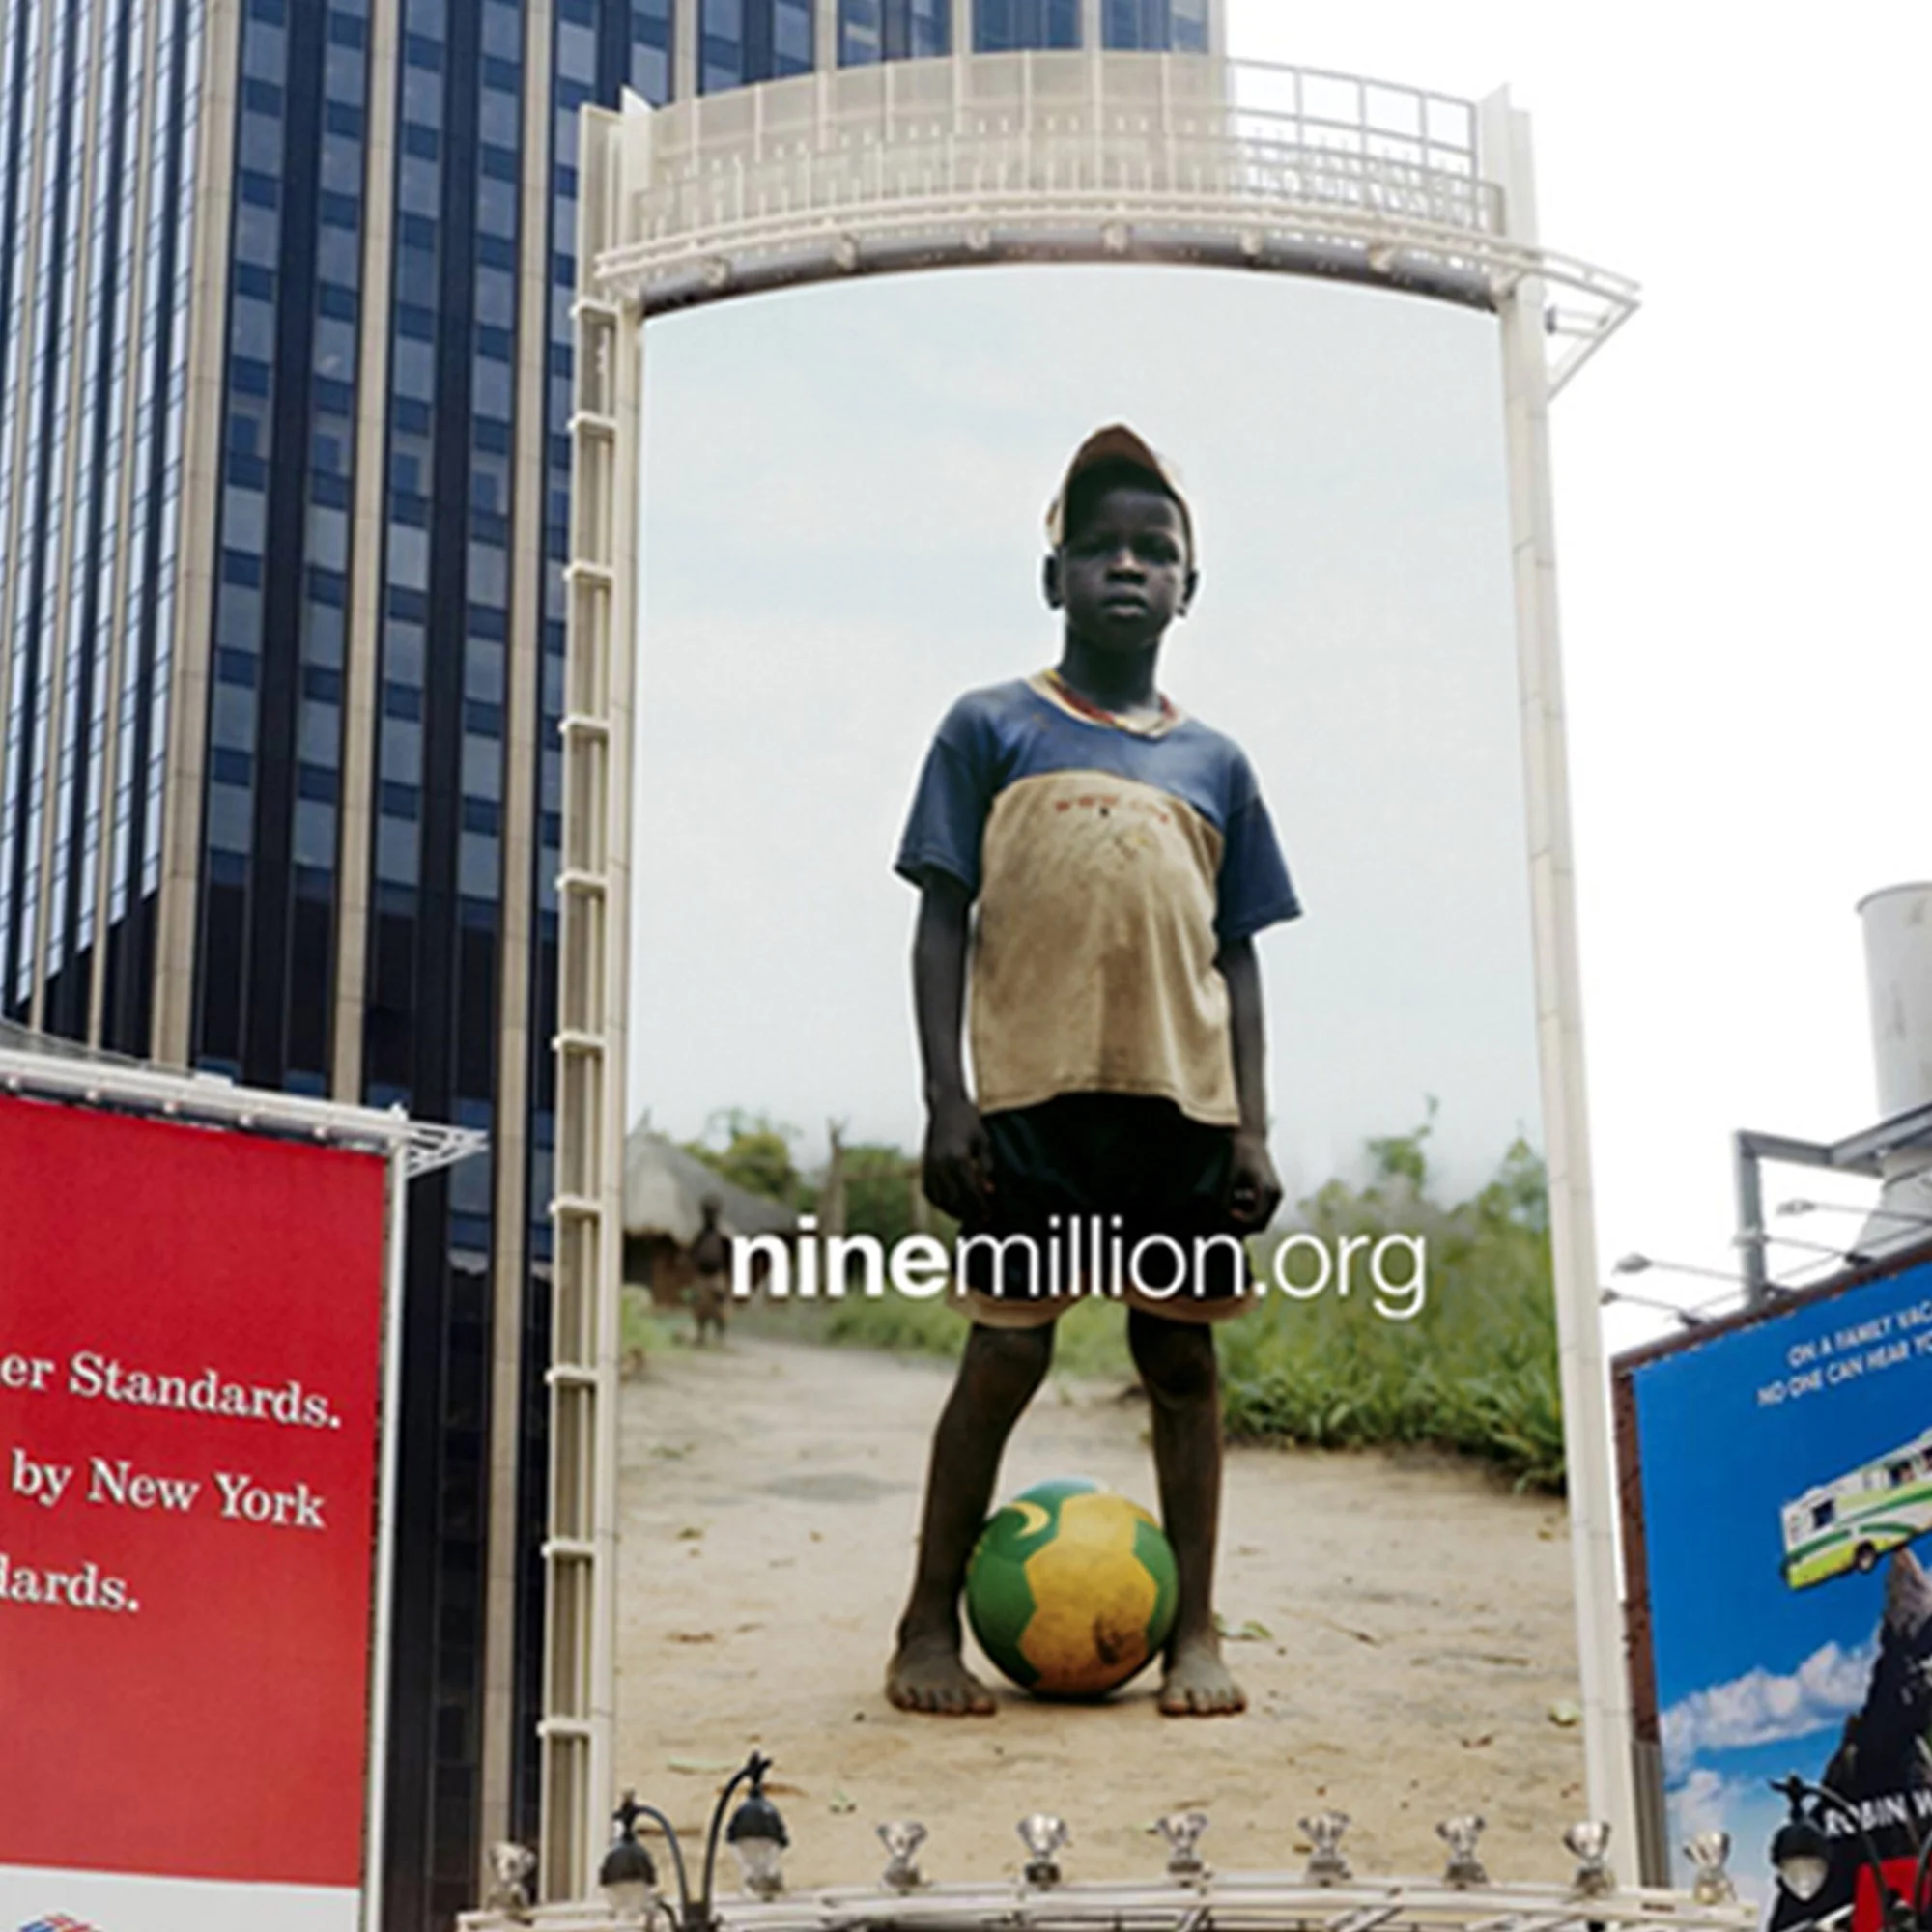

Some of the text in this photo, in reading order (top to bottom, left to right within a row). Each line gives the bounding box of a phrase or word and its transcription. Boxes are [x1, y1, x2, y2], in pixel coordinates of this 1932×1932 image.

[731, 1214, 1427, 1320] ninemillion.org
[1, 1351, 342, 1428] er Standards.
[1757, 1380, 1786, 1406] NO
[1789, 1368, 1822, 1398] ONE
[1827, 1354, 1862, 1385] CAN
[1789, 1341, 1817, 1368] ON
[1821, 1334, 1833, 1356] A
[12, 1449, 326, 1529] by New York
